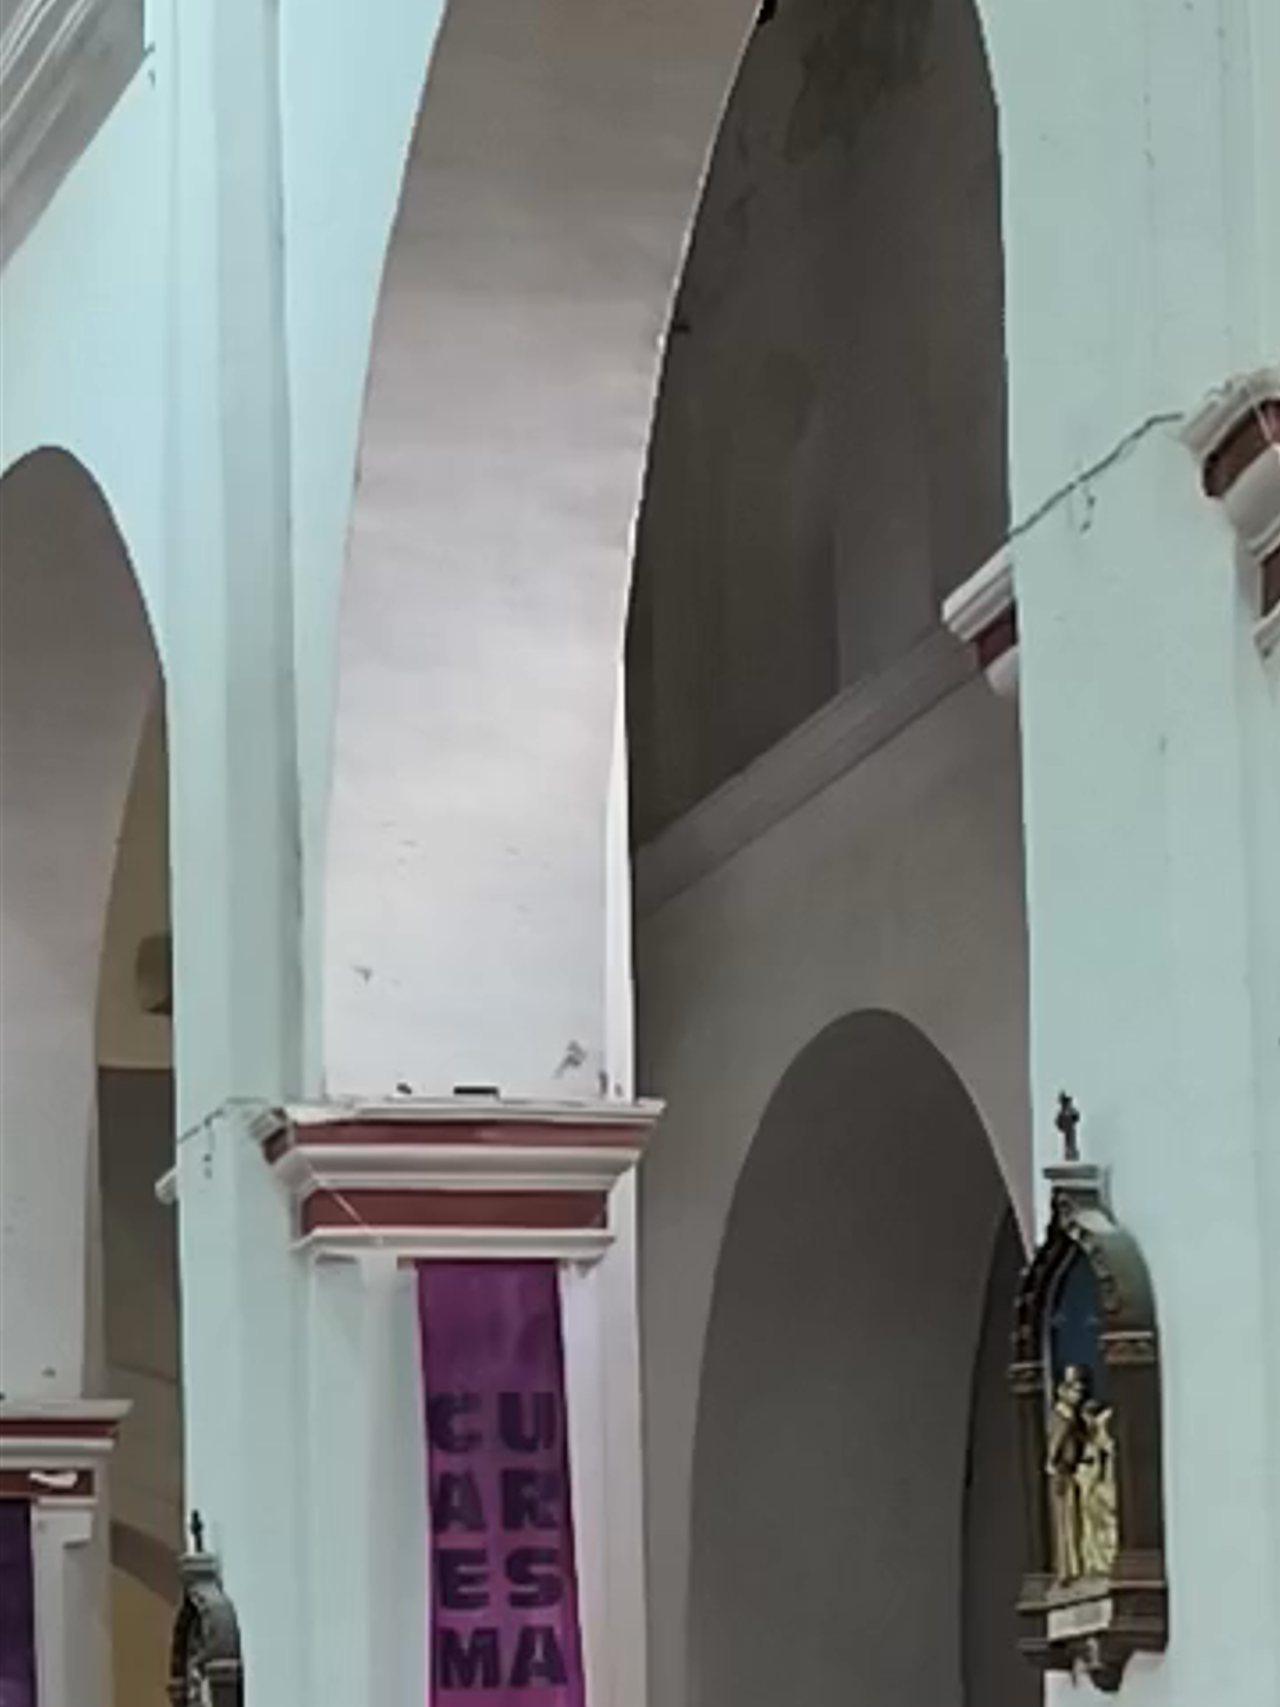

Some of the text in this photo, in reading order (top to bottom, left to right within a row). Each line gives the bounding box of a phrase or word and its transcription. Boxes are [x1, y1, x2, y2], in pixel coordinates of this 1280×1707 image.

[428, 1392, 558, 1453] CU
[432, 1469, 561, 1531] AR
[438, 1548, 566, 1611] ES
[438, 1625, 569, 1689] MA
